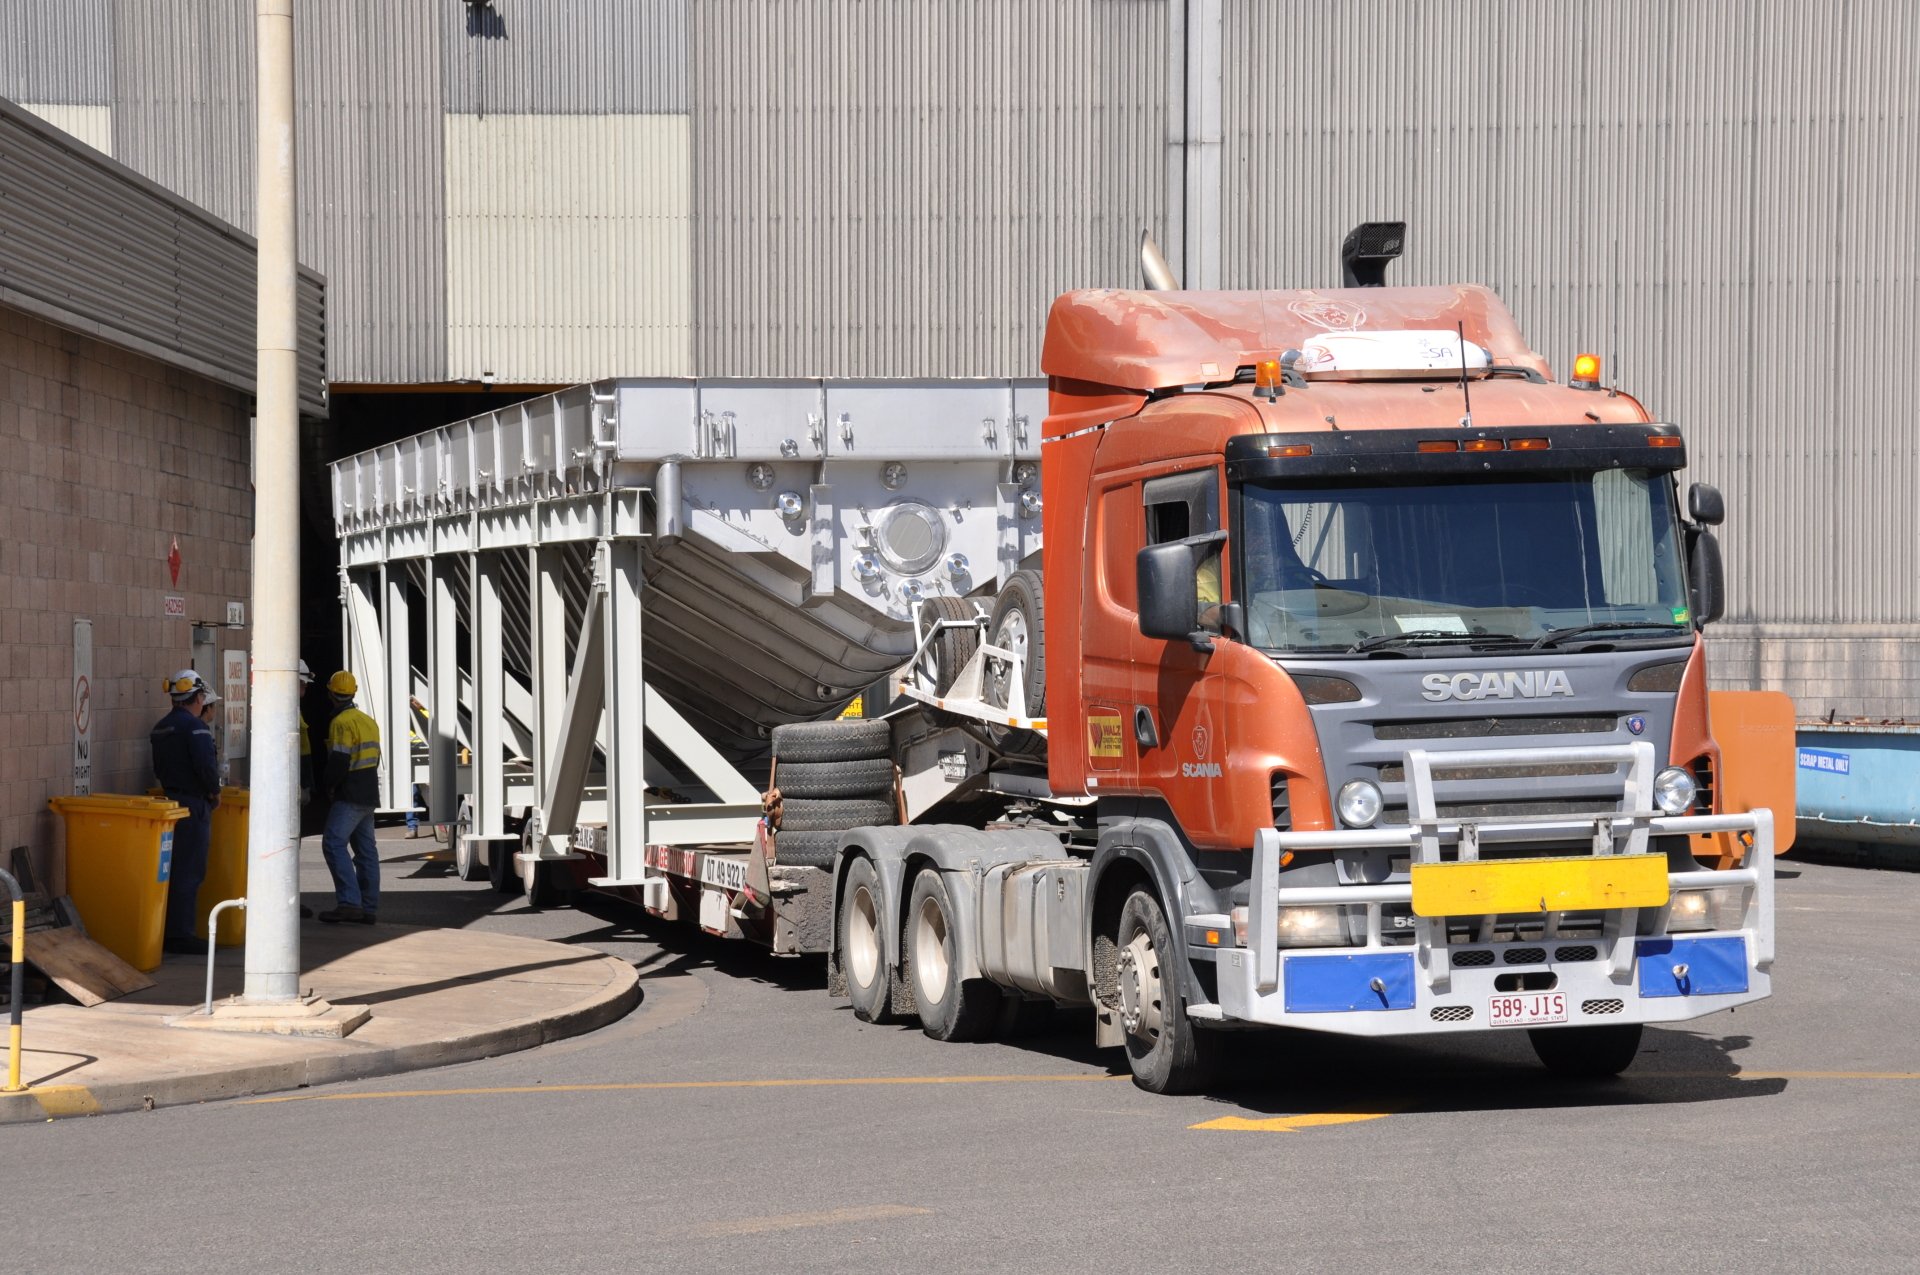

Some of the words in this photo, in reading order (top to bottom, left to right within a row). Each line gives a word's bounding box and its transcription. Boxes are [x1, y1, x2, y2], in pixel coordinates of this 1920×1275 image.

[165, 599, 184, 614] HAZCHEM
[1421, 670, 1575, 701] SCANIA
[1103, 725, 1121, 736] WALZ
[77, 740, 88, 760] NO
[1182, 762, 1223, 777] SCANIA
[1800, 753, 1817, 767] SCRAP
[1818, 756, 1834, 770] METAL
[1835, 758, 1848, 772] ONLY
[75, 766, 90, 779] RIGHT
[669, 848, 697, 877] DIVISION
[707, 859, 715, 882] 07
[717, 861, 726, 885] 49
[727, 864, 740, 888] 922
